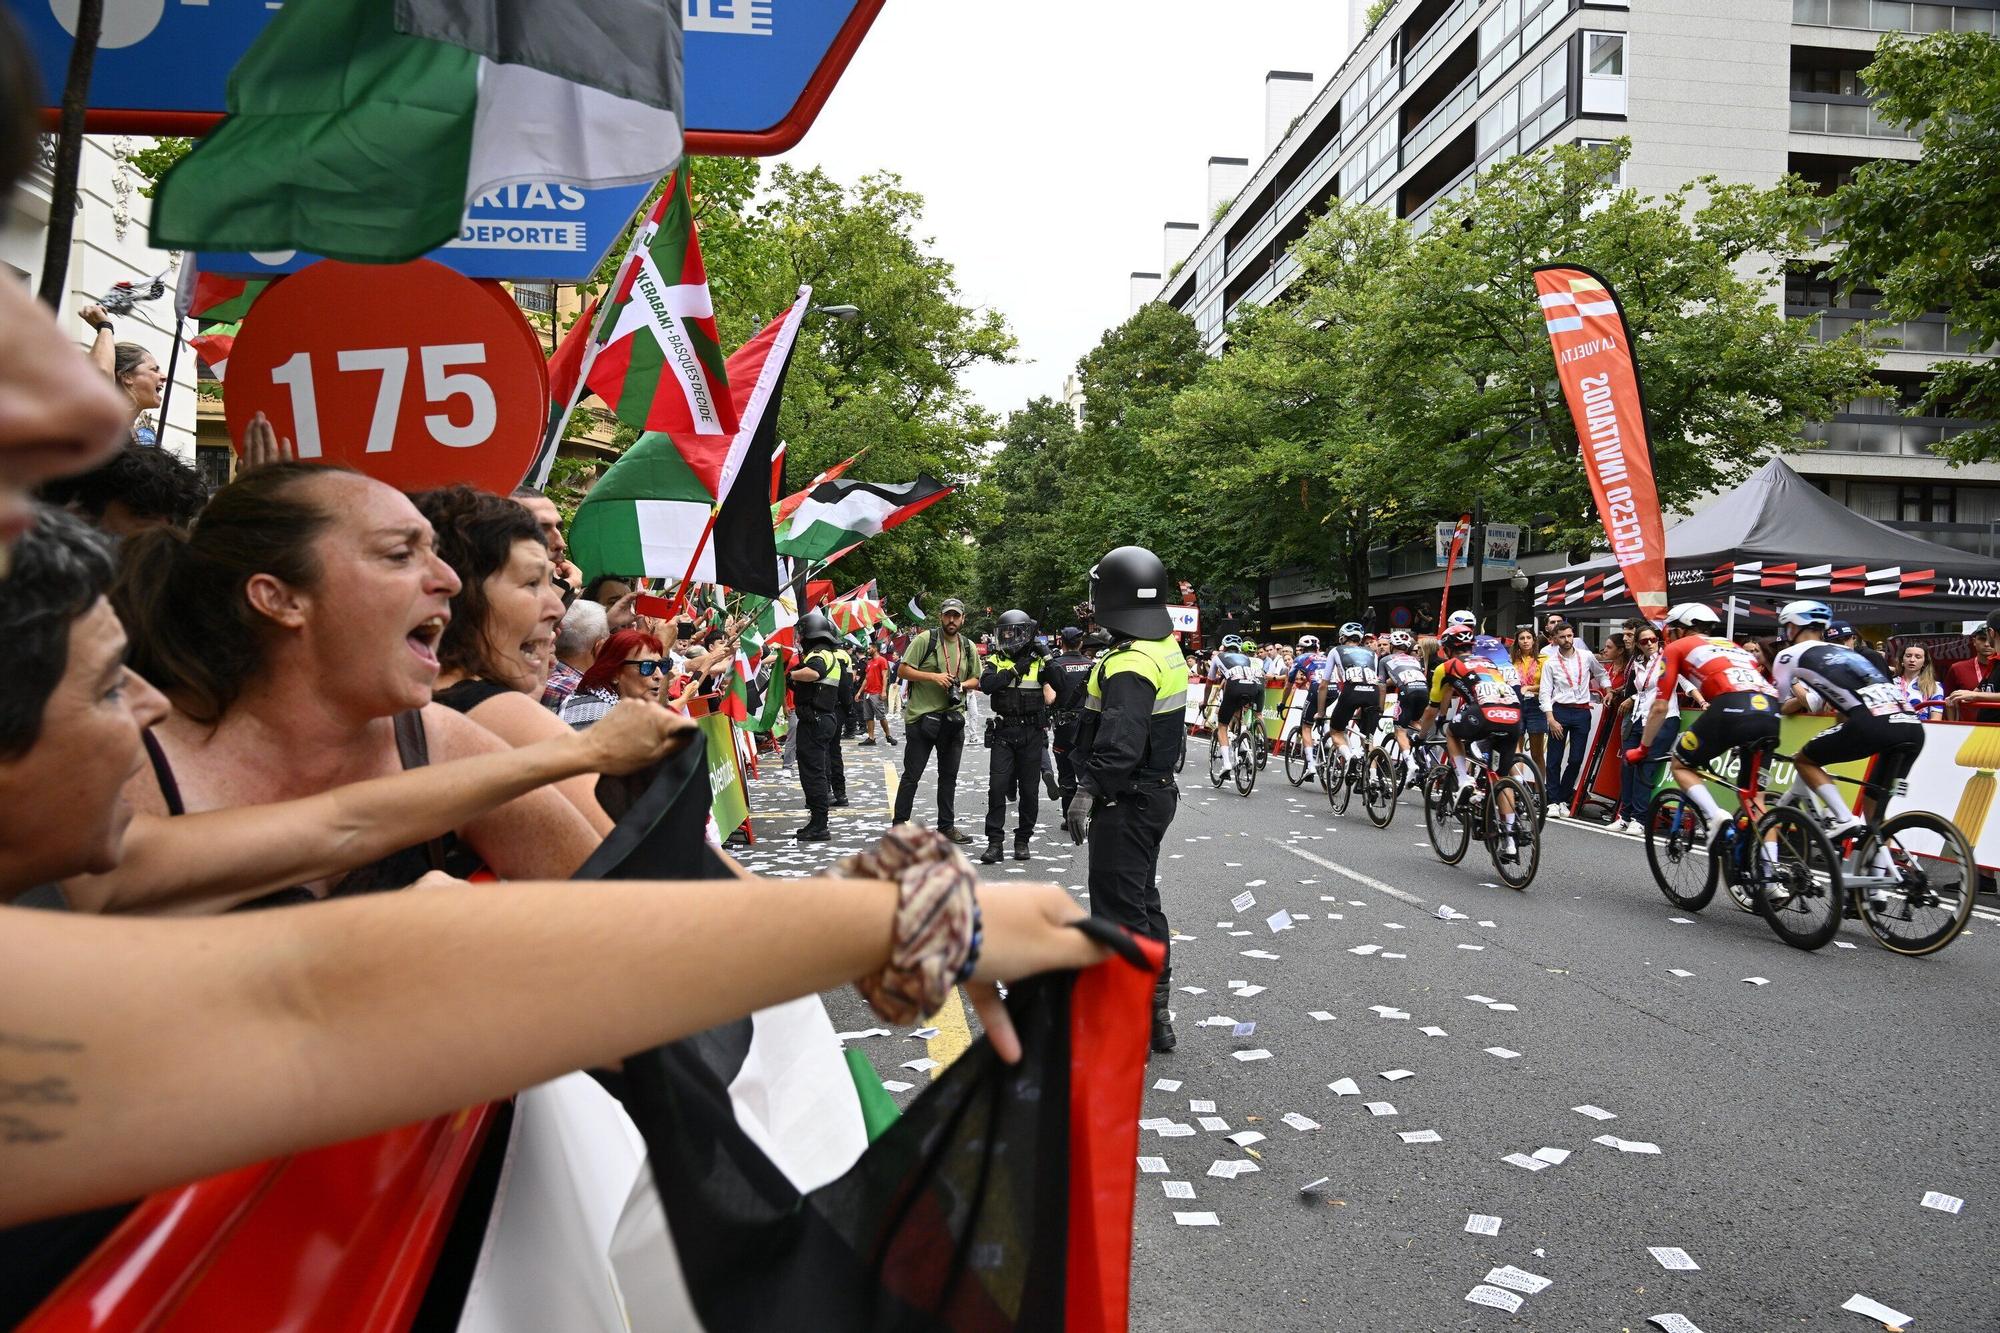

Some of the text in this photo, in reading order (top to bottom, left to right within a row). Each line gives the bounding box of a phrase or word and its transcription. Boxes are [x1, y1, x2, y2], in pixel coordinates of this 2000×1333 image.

[461, 225, 568, 244] DEPORTE
[639, 280, 675, 330] ERABAKI
[667, 334, 700, 381] BASQUES
[691, 382, 713, 423] DECIDE
[271, 342, 498, 459] 175
[1947, 577, 1966, 596] LA
[1487, 710, 1518, 720] caps
